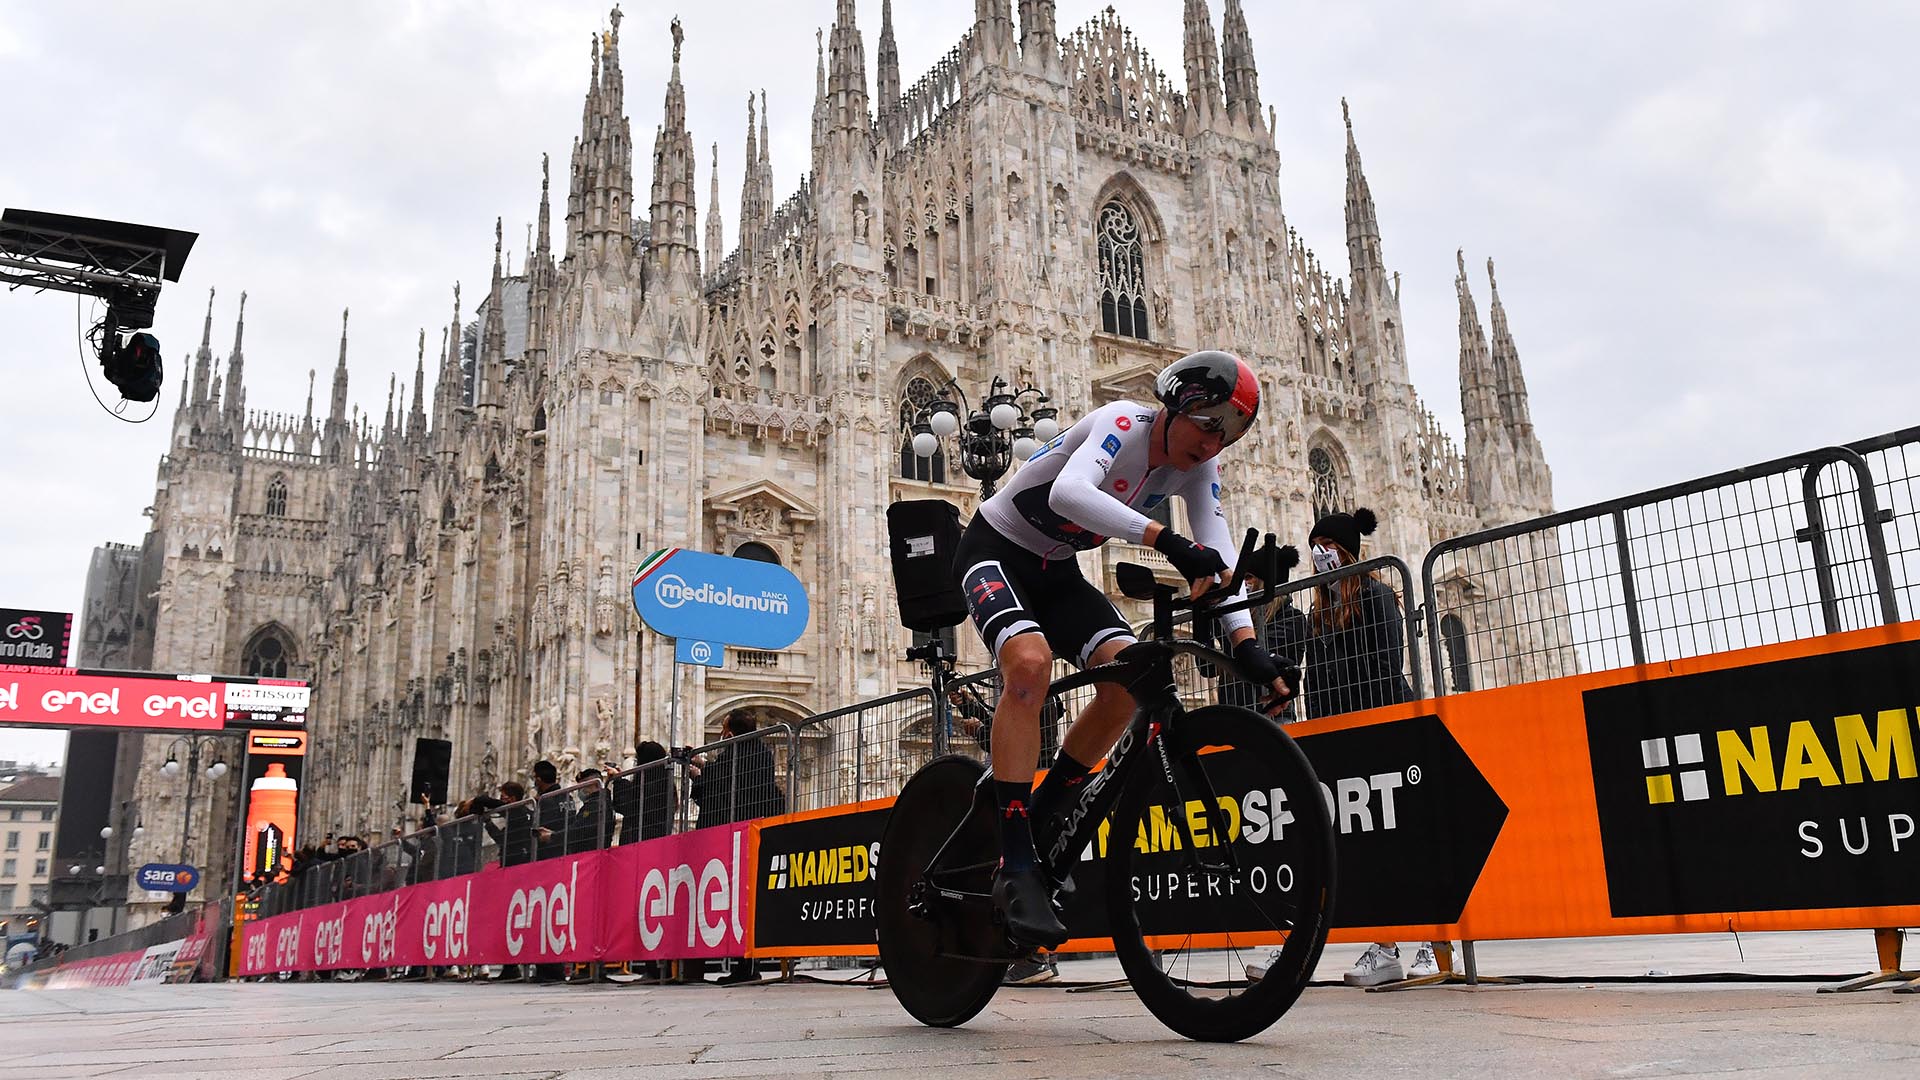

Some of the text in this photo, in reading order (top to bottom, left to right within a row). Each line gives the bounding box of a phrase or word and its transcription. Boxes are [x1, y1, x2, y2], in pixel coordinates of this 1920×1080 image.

[656, 576, 789, 615] mediolanum
[761, 590, 788, 601] BANCA
[0, 641, 15, 656] iro
[41, 687, 120, 715] enel
[143, 692, 218, 720] enel
[254, 690, 304, 700] TISSOT
[1716, 705, 1920, 796] NAM
[1048, 729, 1134, 868] PINARELLO
[143, 870, 176, 881] sara
[789, 842, 881, 888] NAMEDS
[1131, 863, 1294, 902] SUPERFOO
[314, 905, 347, 966] enel
[361, 894, 399, 963] enel
[423, 880, 471, 960] enel
[506, 861, 578, 957] enel
[638, 831, 744, 952] enel
[800, 897, 876, 921] SUPERF
